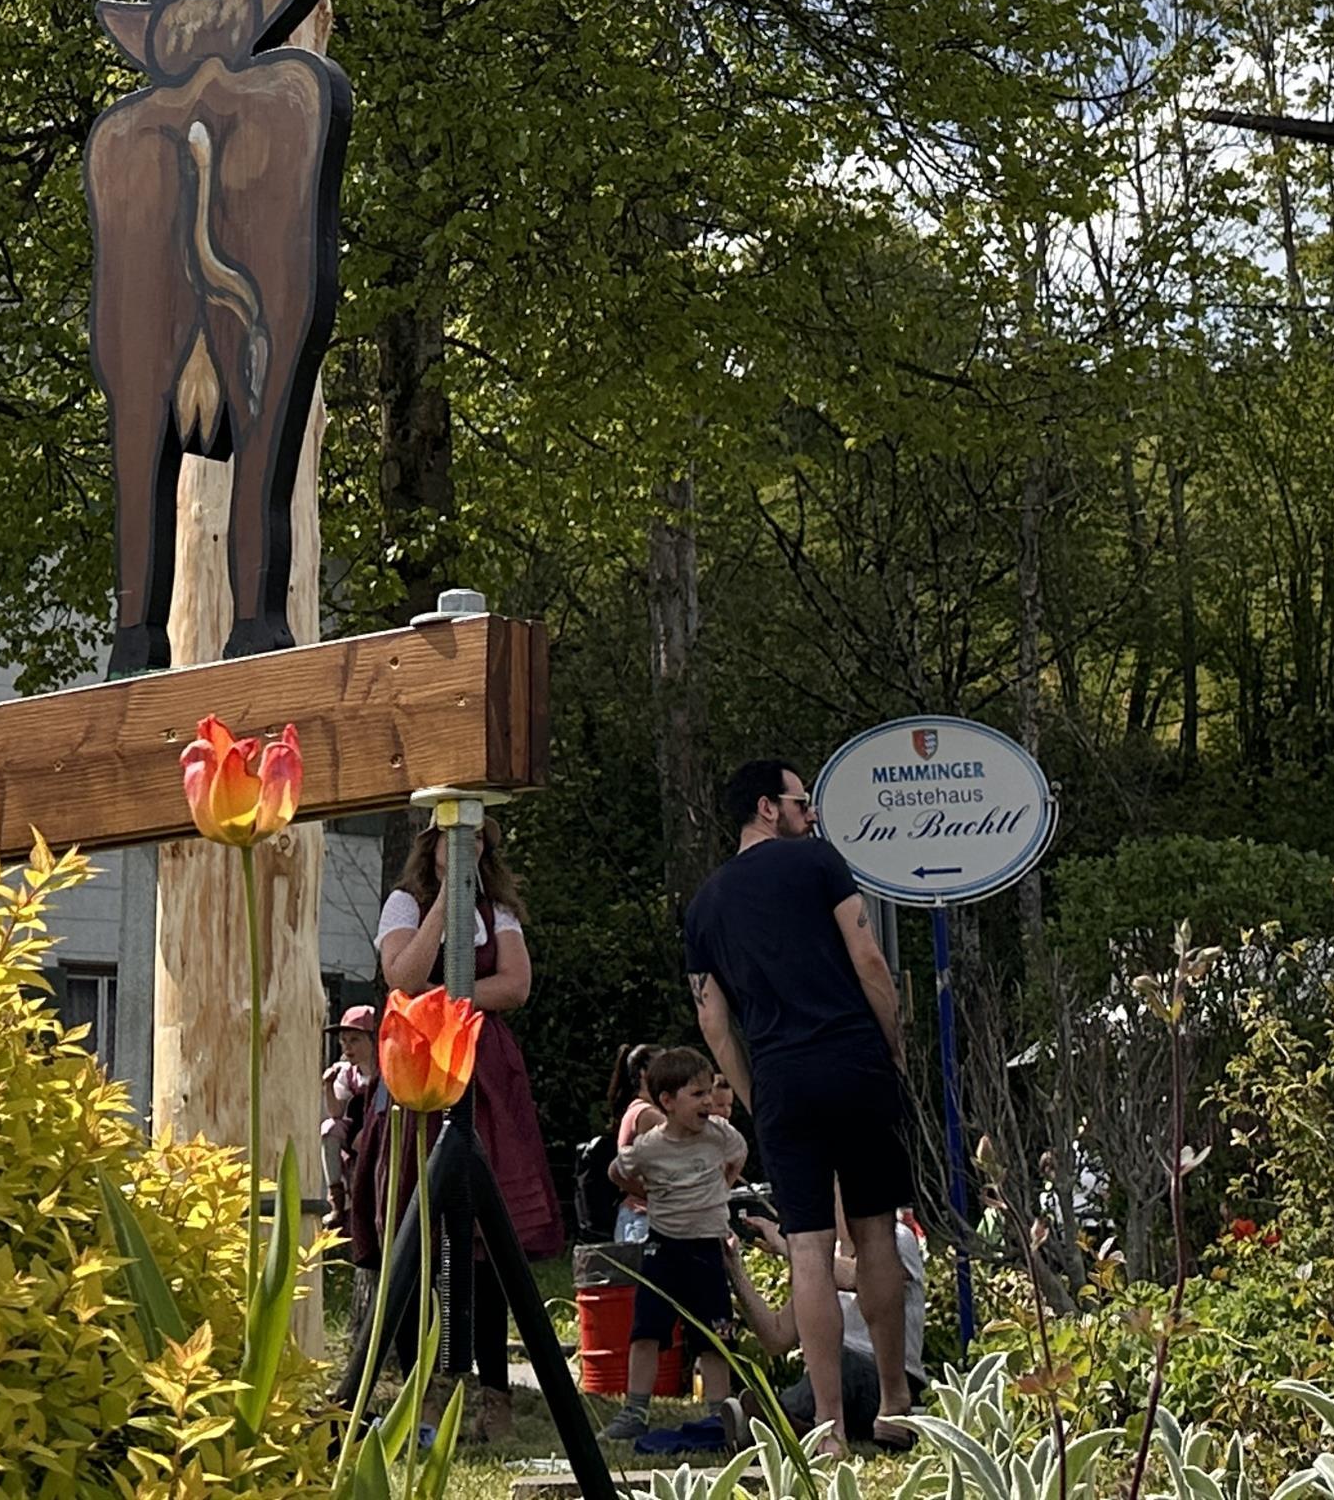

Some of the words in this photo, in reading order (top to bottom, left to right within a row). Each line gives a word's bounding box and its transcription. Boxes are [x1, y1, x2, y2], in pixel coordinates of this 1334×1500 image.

[872, 761, 985, 784] MEMMINGER
[877, 788, 984, 809] Gästehaus
[843, 812, 898, 843] Im
[907, 804, 1030, 840] Bachtl
